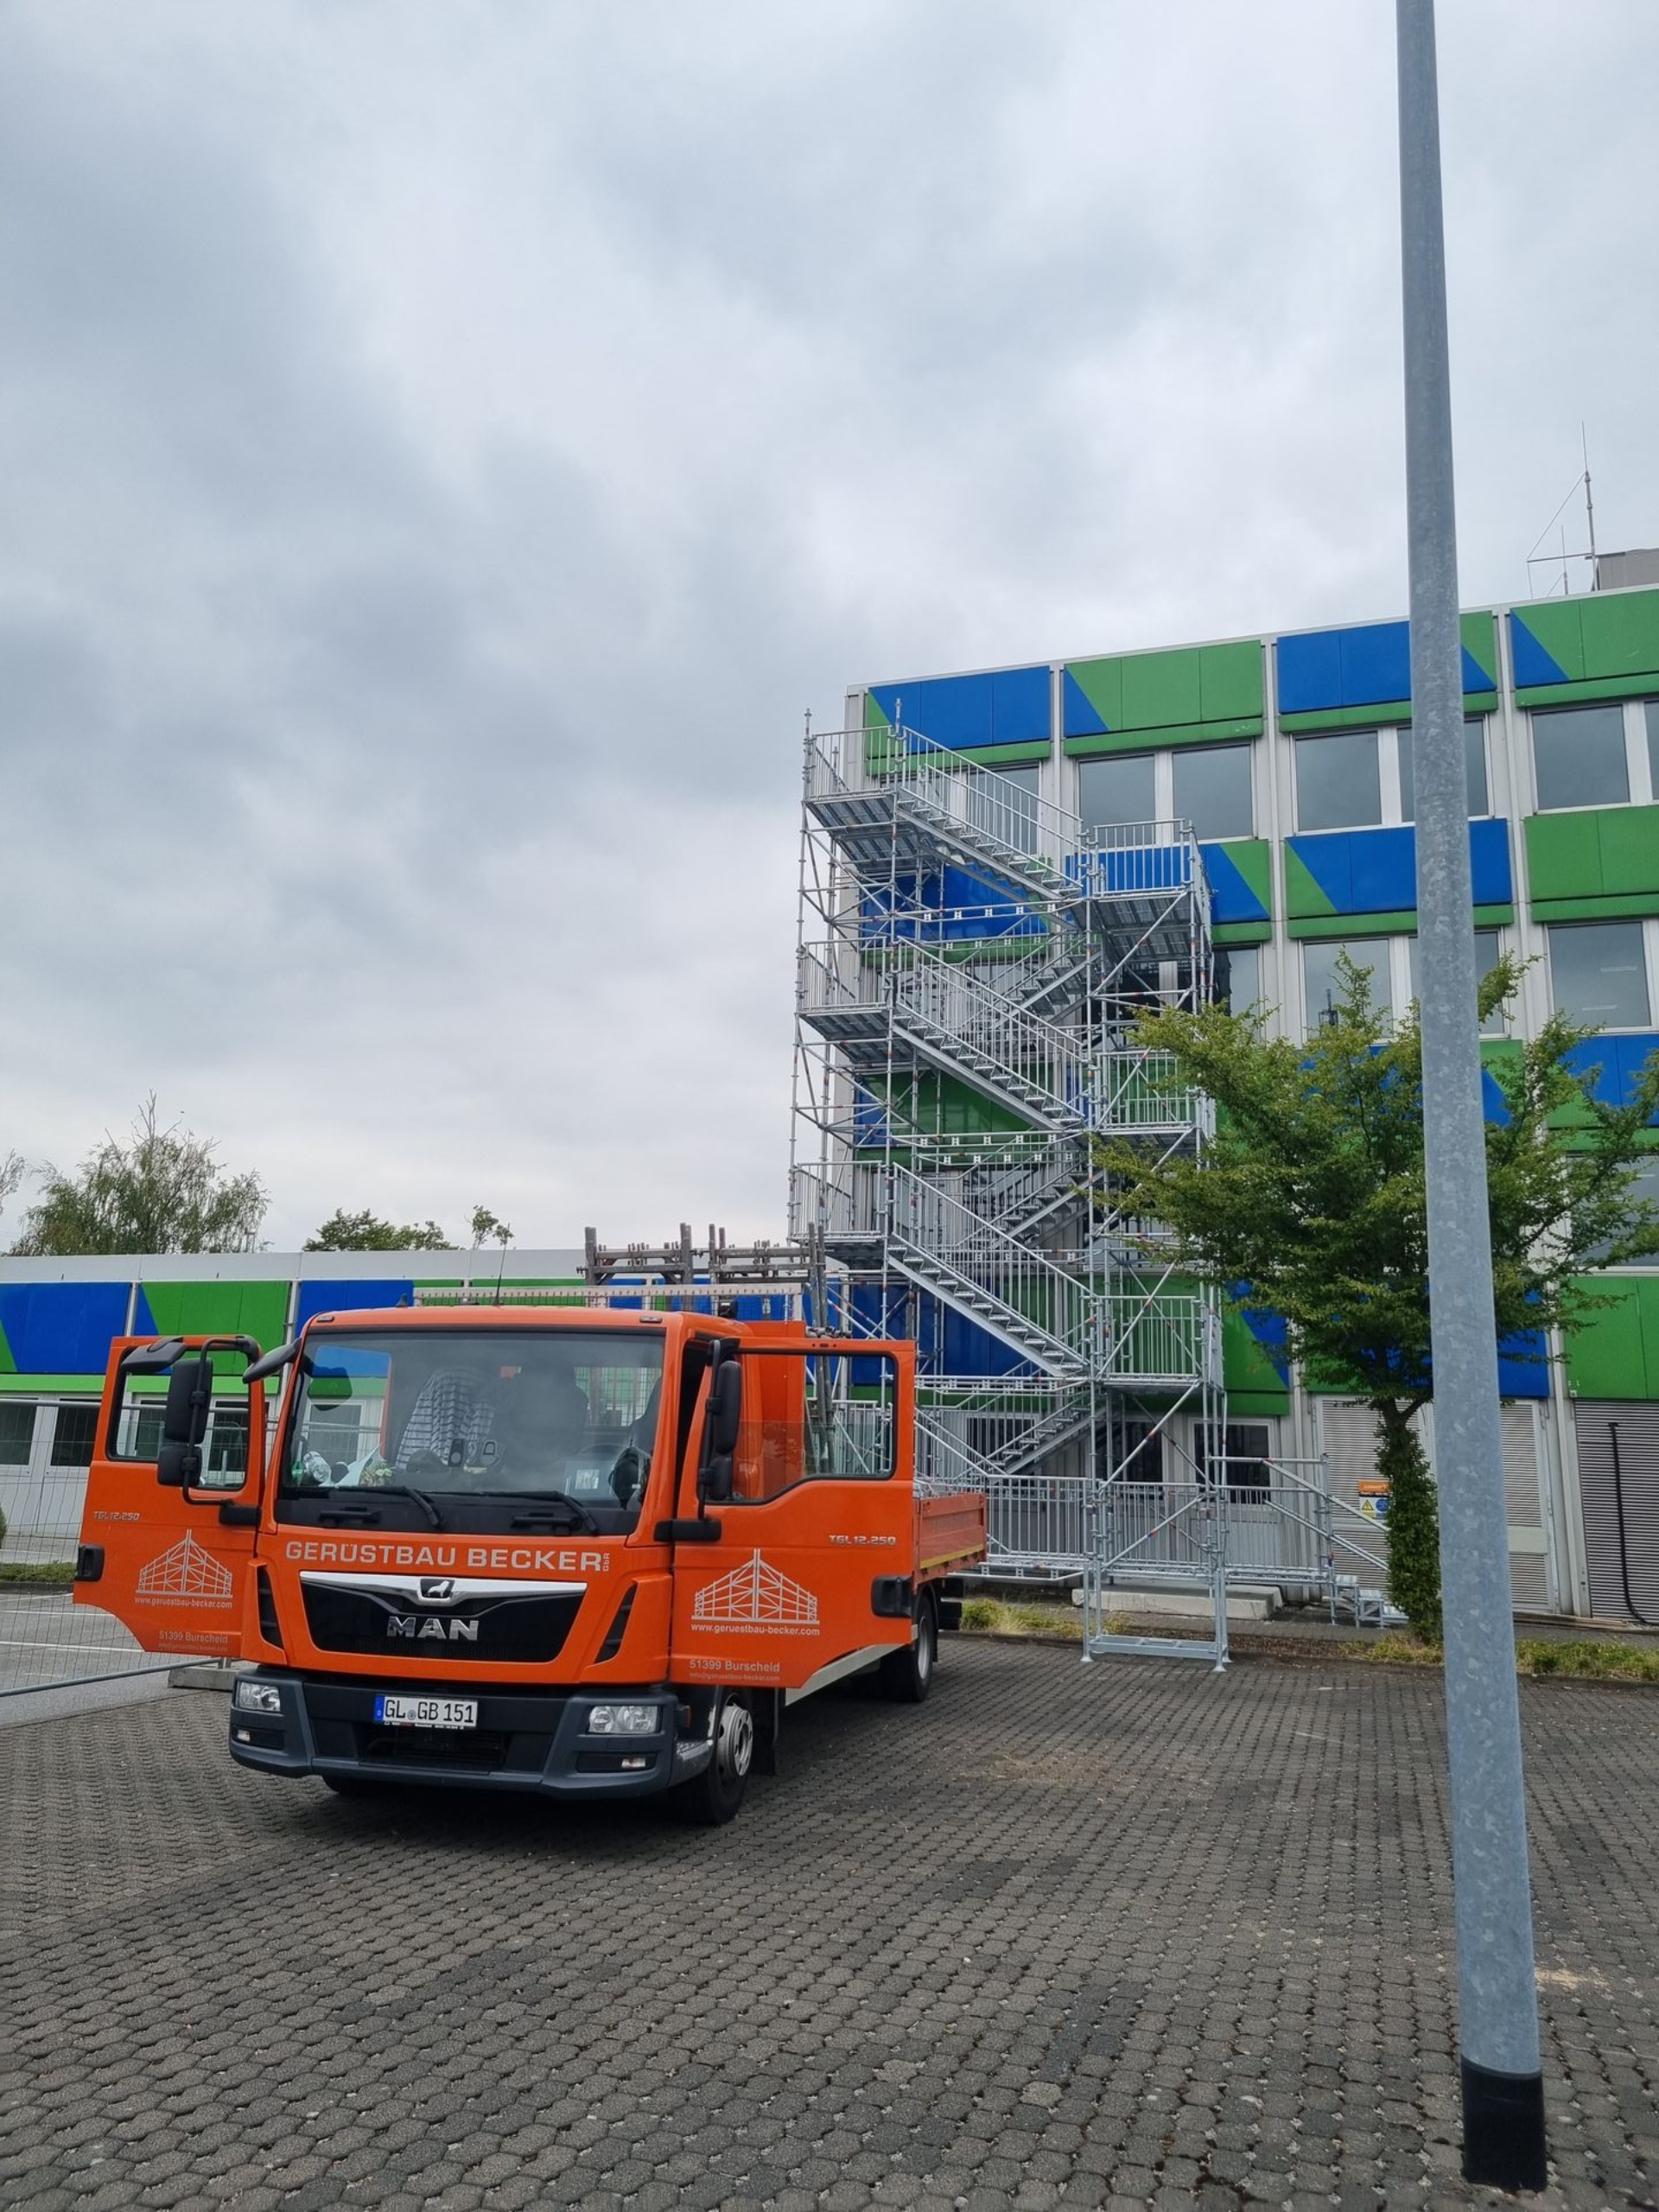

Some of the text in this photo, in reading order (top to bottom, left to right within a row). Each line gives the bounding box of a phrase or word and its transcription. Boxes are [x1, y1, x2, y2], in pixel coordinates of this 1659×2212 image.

[829, 1535, 897, 1546] TGL 12.250
[285, 1541, 602, 1572] GERÜSTBAU BECKER
[134, 1597, 232, 1609] www.geruestbau-becker.com
[386, 1616, 479, 1641] MAN
[690, 1623, 821, 1636] www.geruestbau-becker.com
[158, 1630, 228, 1643] 51399 Burscheid
[690, 1659, 780, 1672] 51399 Burscheid
[385, 1700, 474, 1724] GL GB 151
